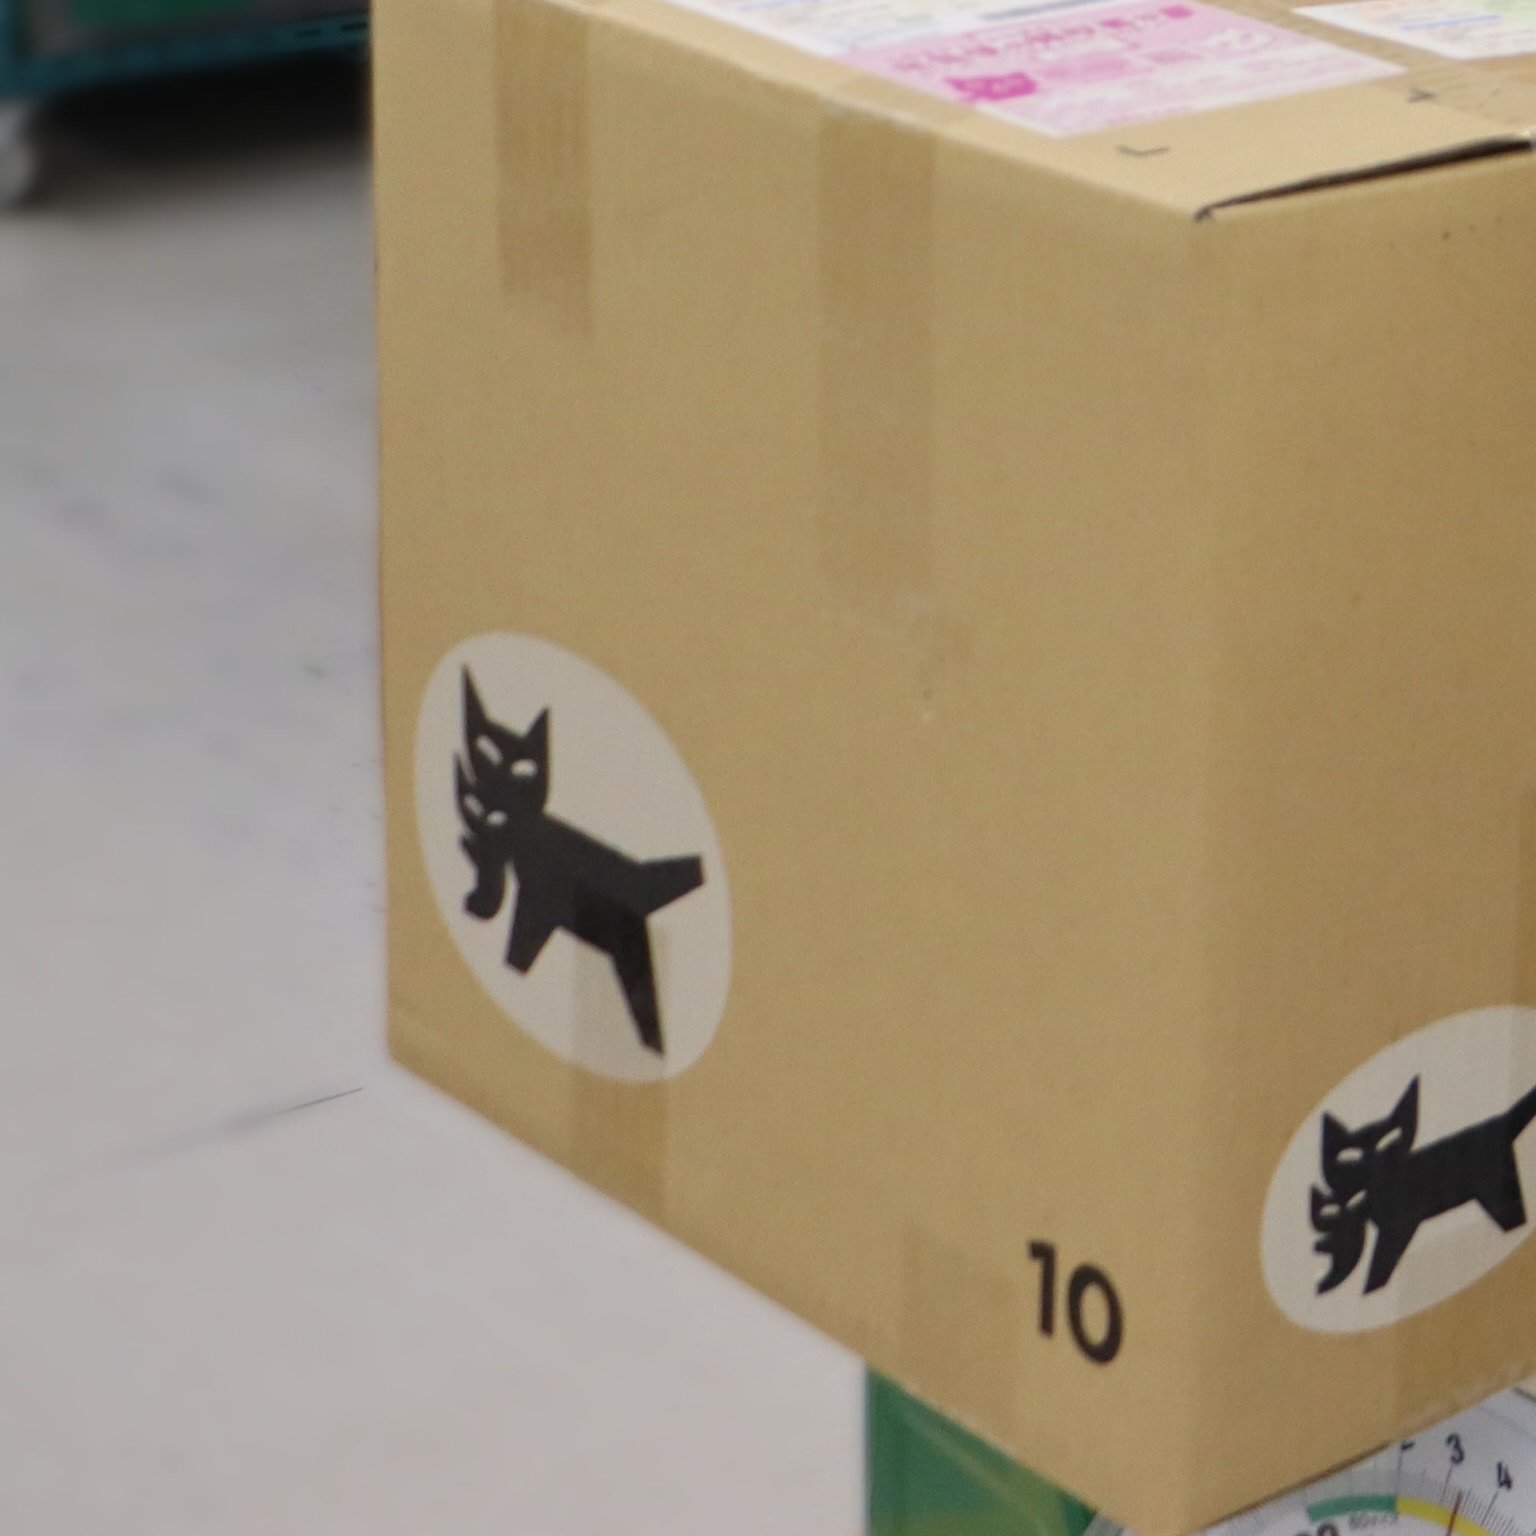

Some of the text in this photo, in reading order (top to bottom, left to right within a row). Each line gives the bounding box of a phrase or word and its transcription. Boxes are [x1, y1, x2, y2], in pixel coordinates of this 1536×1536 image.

[1027, 1239, 1124, 1365] 10
[1446, 1433, 1465, 1465] 3
[1496, 1461, 1514, 1492] 4
